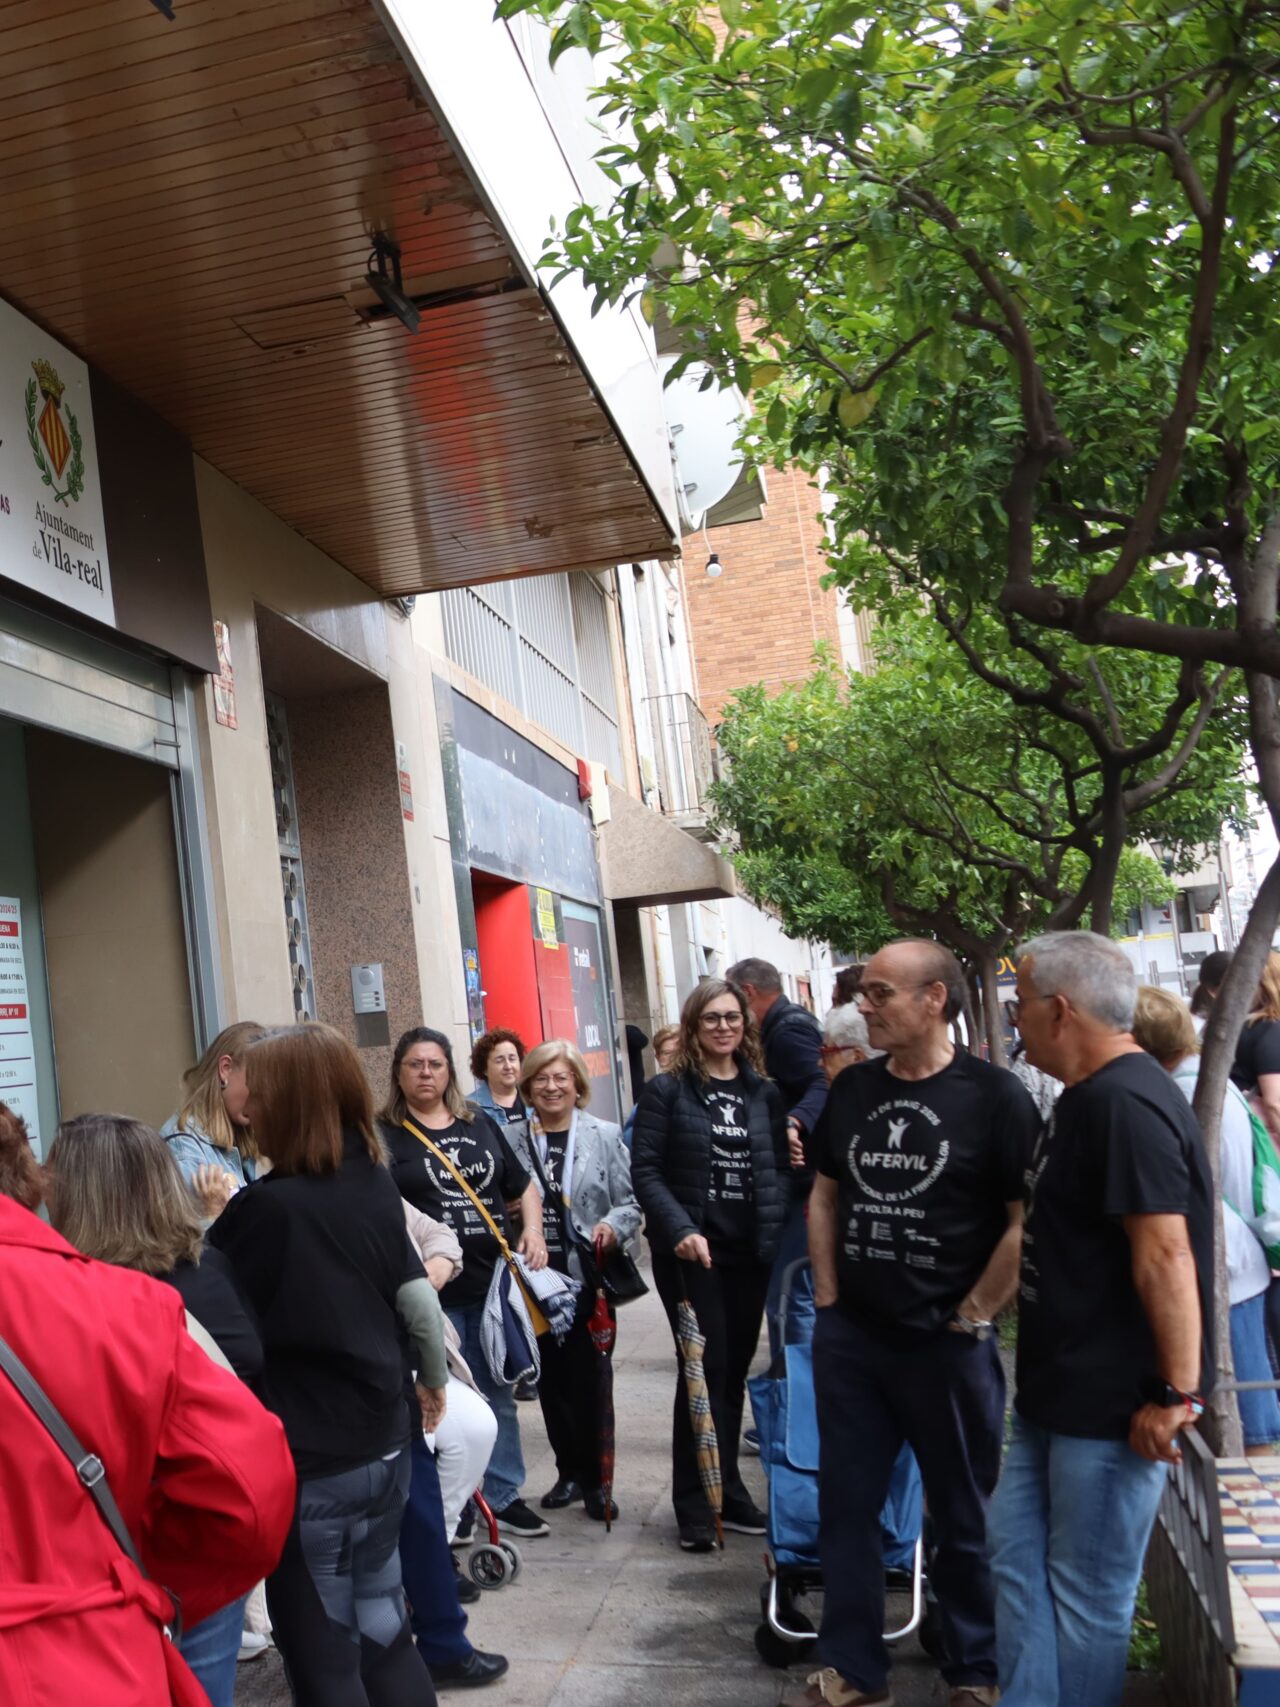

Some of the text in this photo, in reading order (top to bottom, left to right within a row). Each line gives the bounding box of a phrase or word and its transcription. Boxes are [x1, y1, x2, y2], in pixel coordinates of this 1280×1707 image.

[35, 499, 95, 552] Ajuntament
[32, 528, 104, 592] de Vila-real
[878, 1102, 892, 1114] DE
[893, 1100, 921, 1110] MAIG
[718, 1160, 740, 1168] VOLTA
[860, 1151, 929, 1171] AFERVIL
[885, 1192, 898, 1202] DE
[898, 1189, 913, 1200] LA
[452, 1199, 474, 1207] VOLTA
[864, 1204, 926, 1219] VOLTA A PEU
